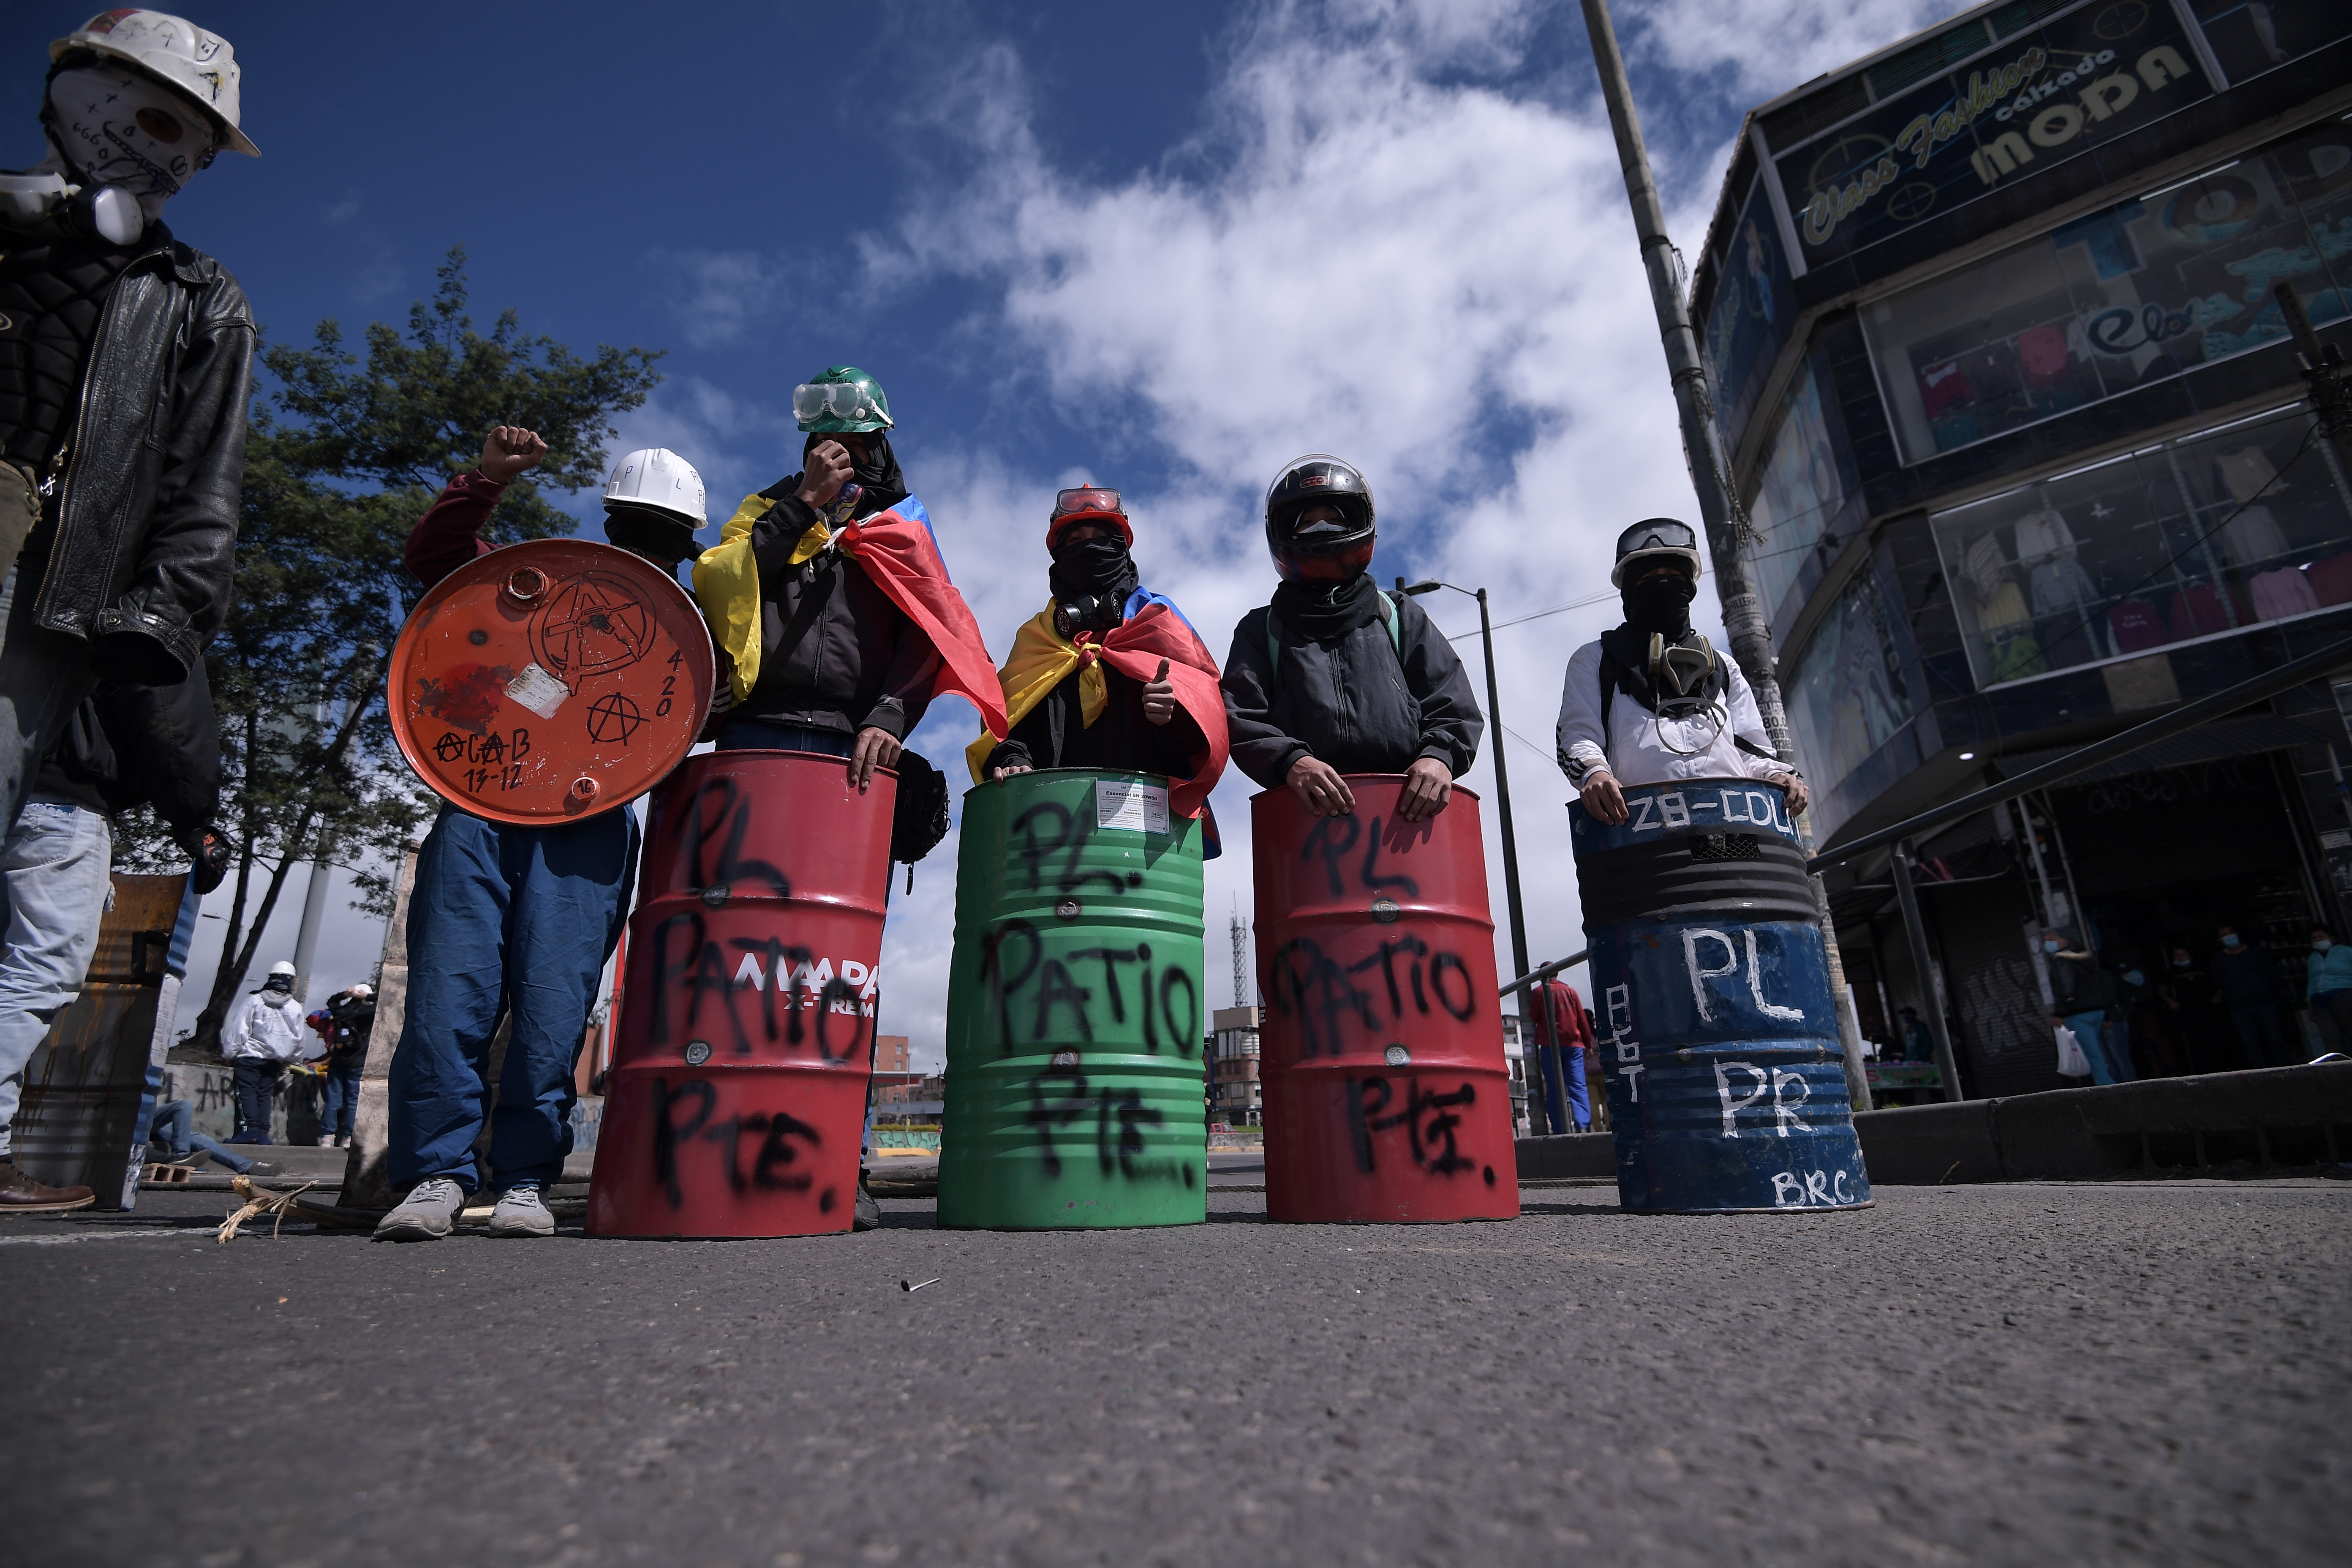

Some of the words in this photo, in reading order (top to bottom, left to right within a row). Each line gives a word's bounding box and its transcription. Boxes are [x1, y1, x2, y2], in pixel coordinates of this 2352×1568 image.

[1803, 157, 1899, 246] Class
[1897, 46, 2047, 169] Fashion
[432, 727, 530, 765] ACAB
[463, 763, 523, 793] 13-12
[1682, 926, 1805, 1022] PL
[1713, 1057, 1817, 1138] PR
[1771, 1169, 1854, 1207] BRC
